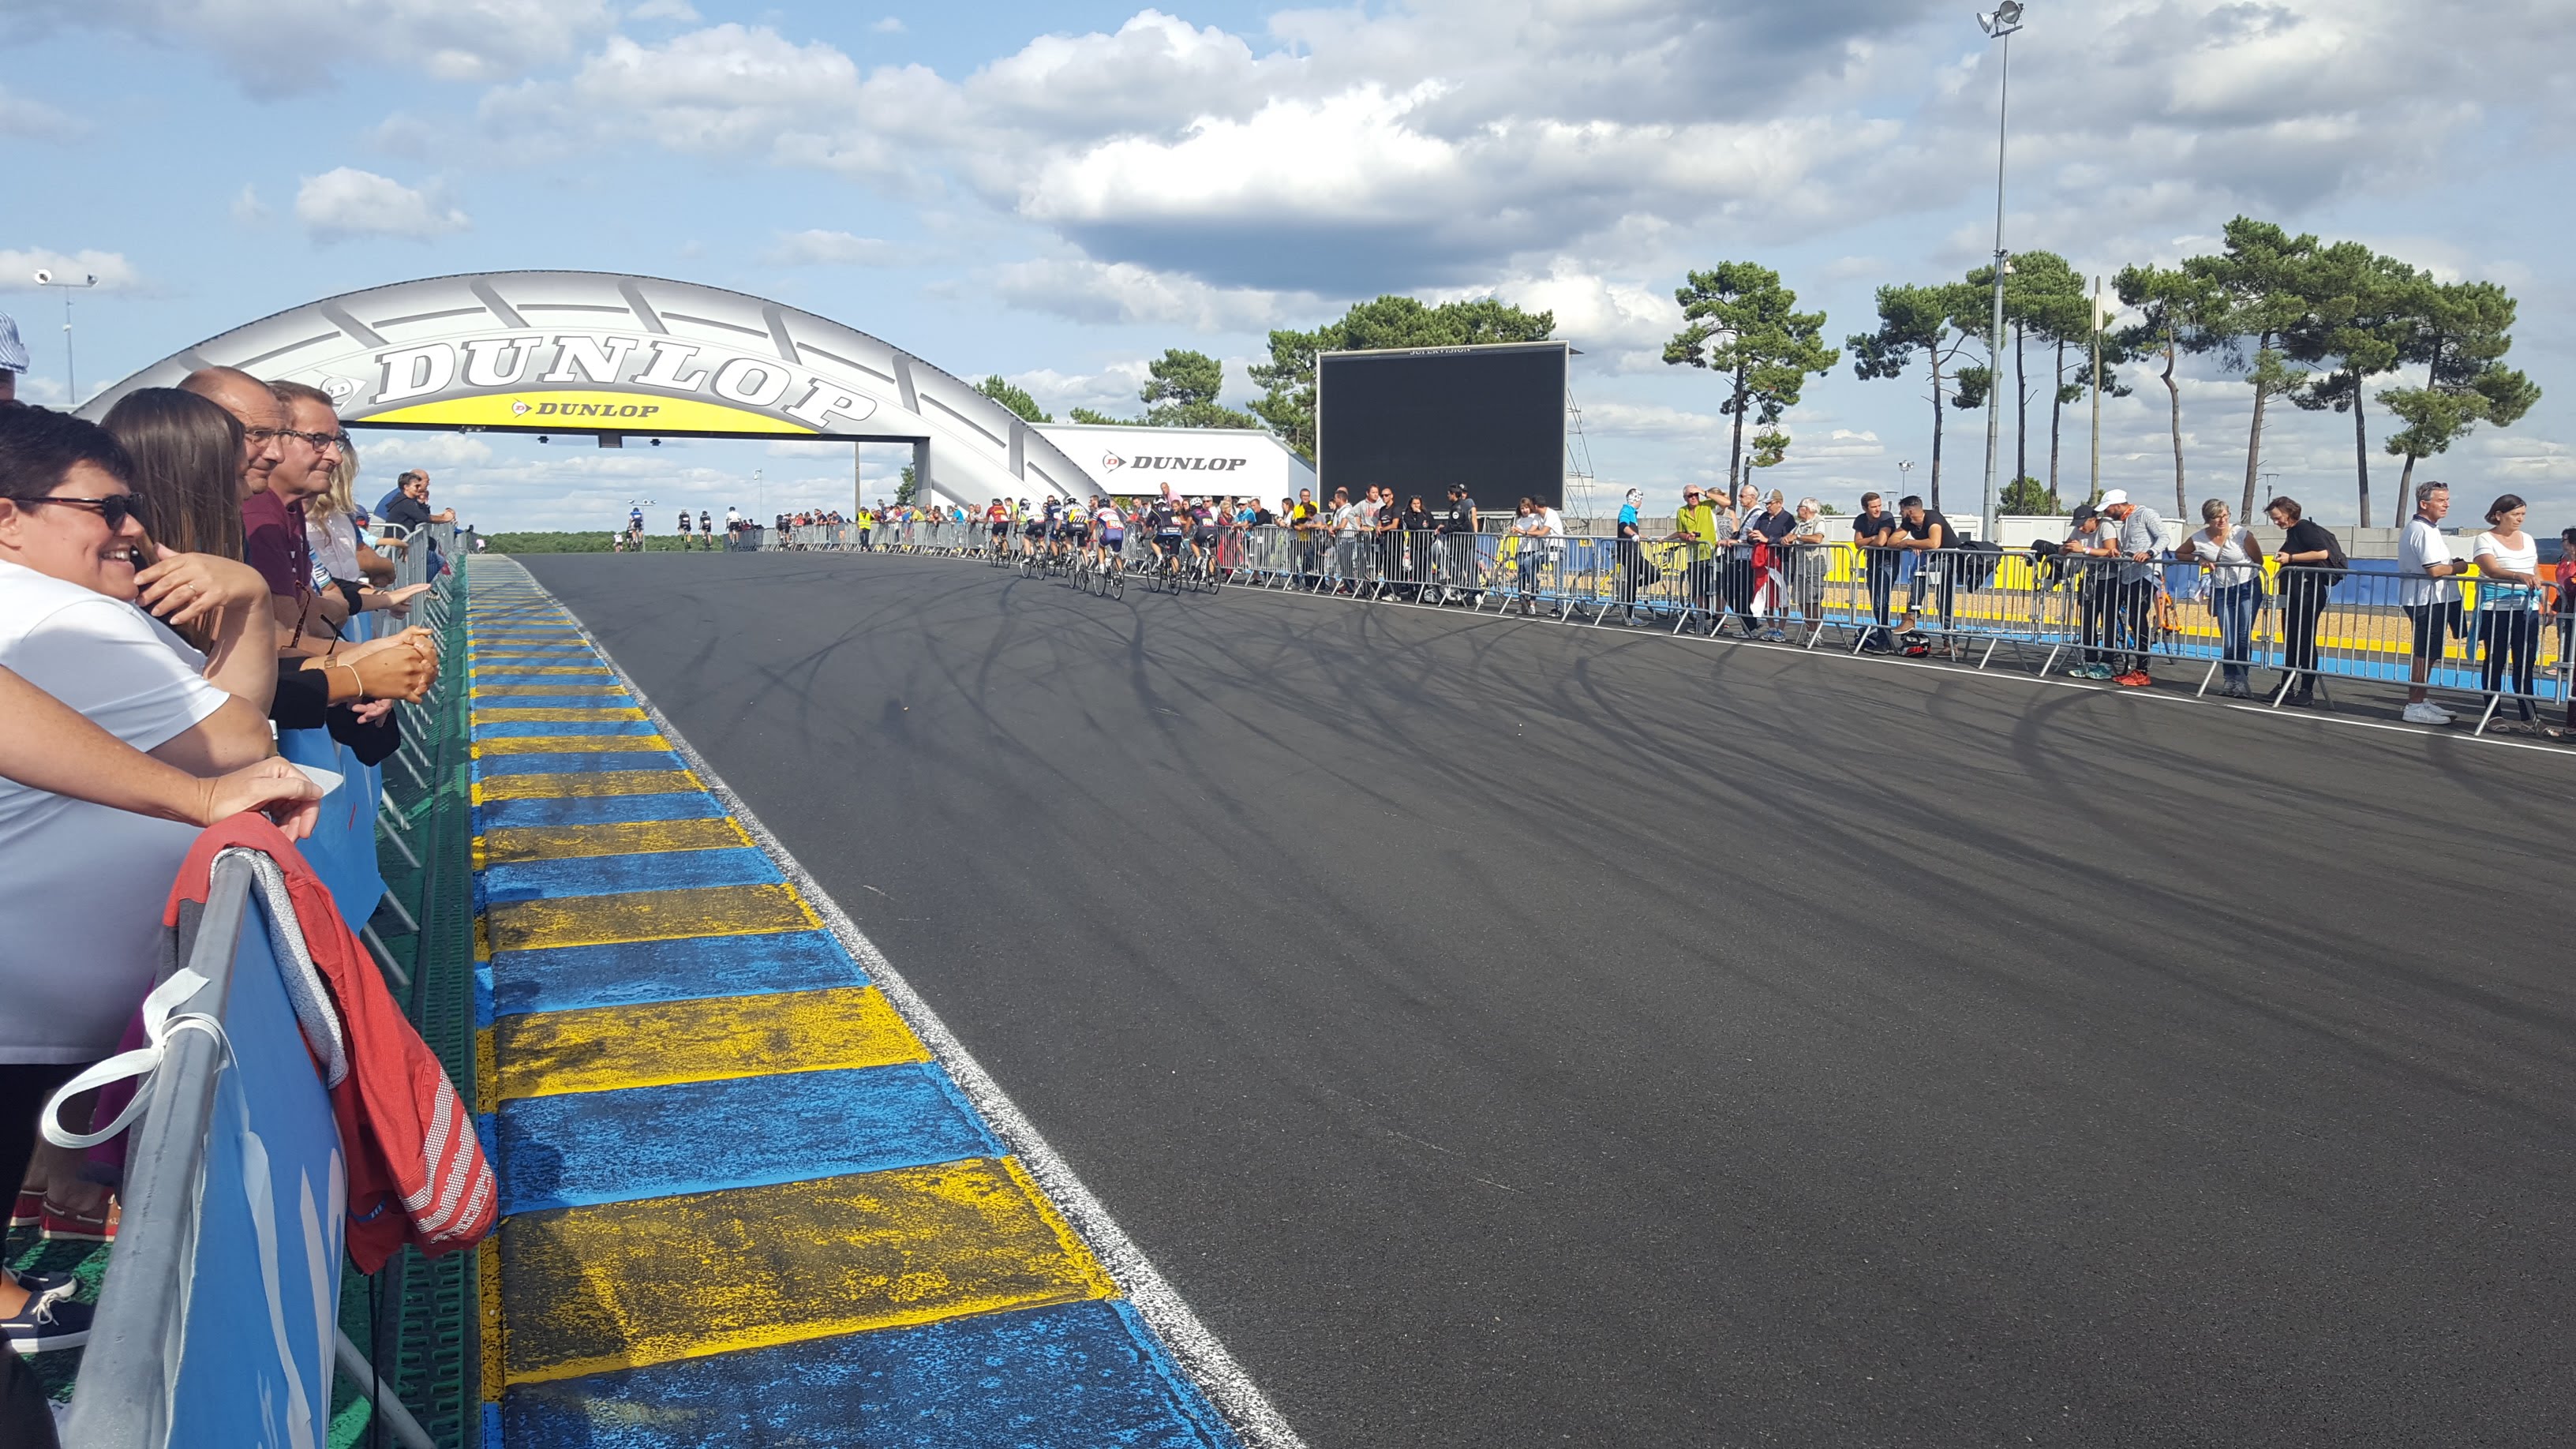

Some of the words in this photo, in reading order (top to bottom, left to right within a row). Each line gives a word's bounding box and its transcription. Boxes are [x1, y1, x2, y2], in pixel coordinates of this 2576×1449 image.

[368, 335, 878, 429] DUNLOP
[535, 402, 660, 417] DUNLOP
[1130, 455, 1247, 471] DUNLOP
